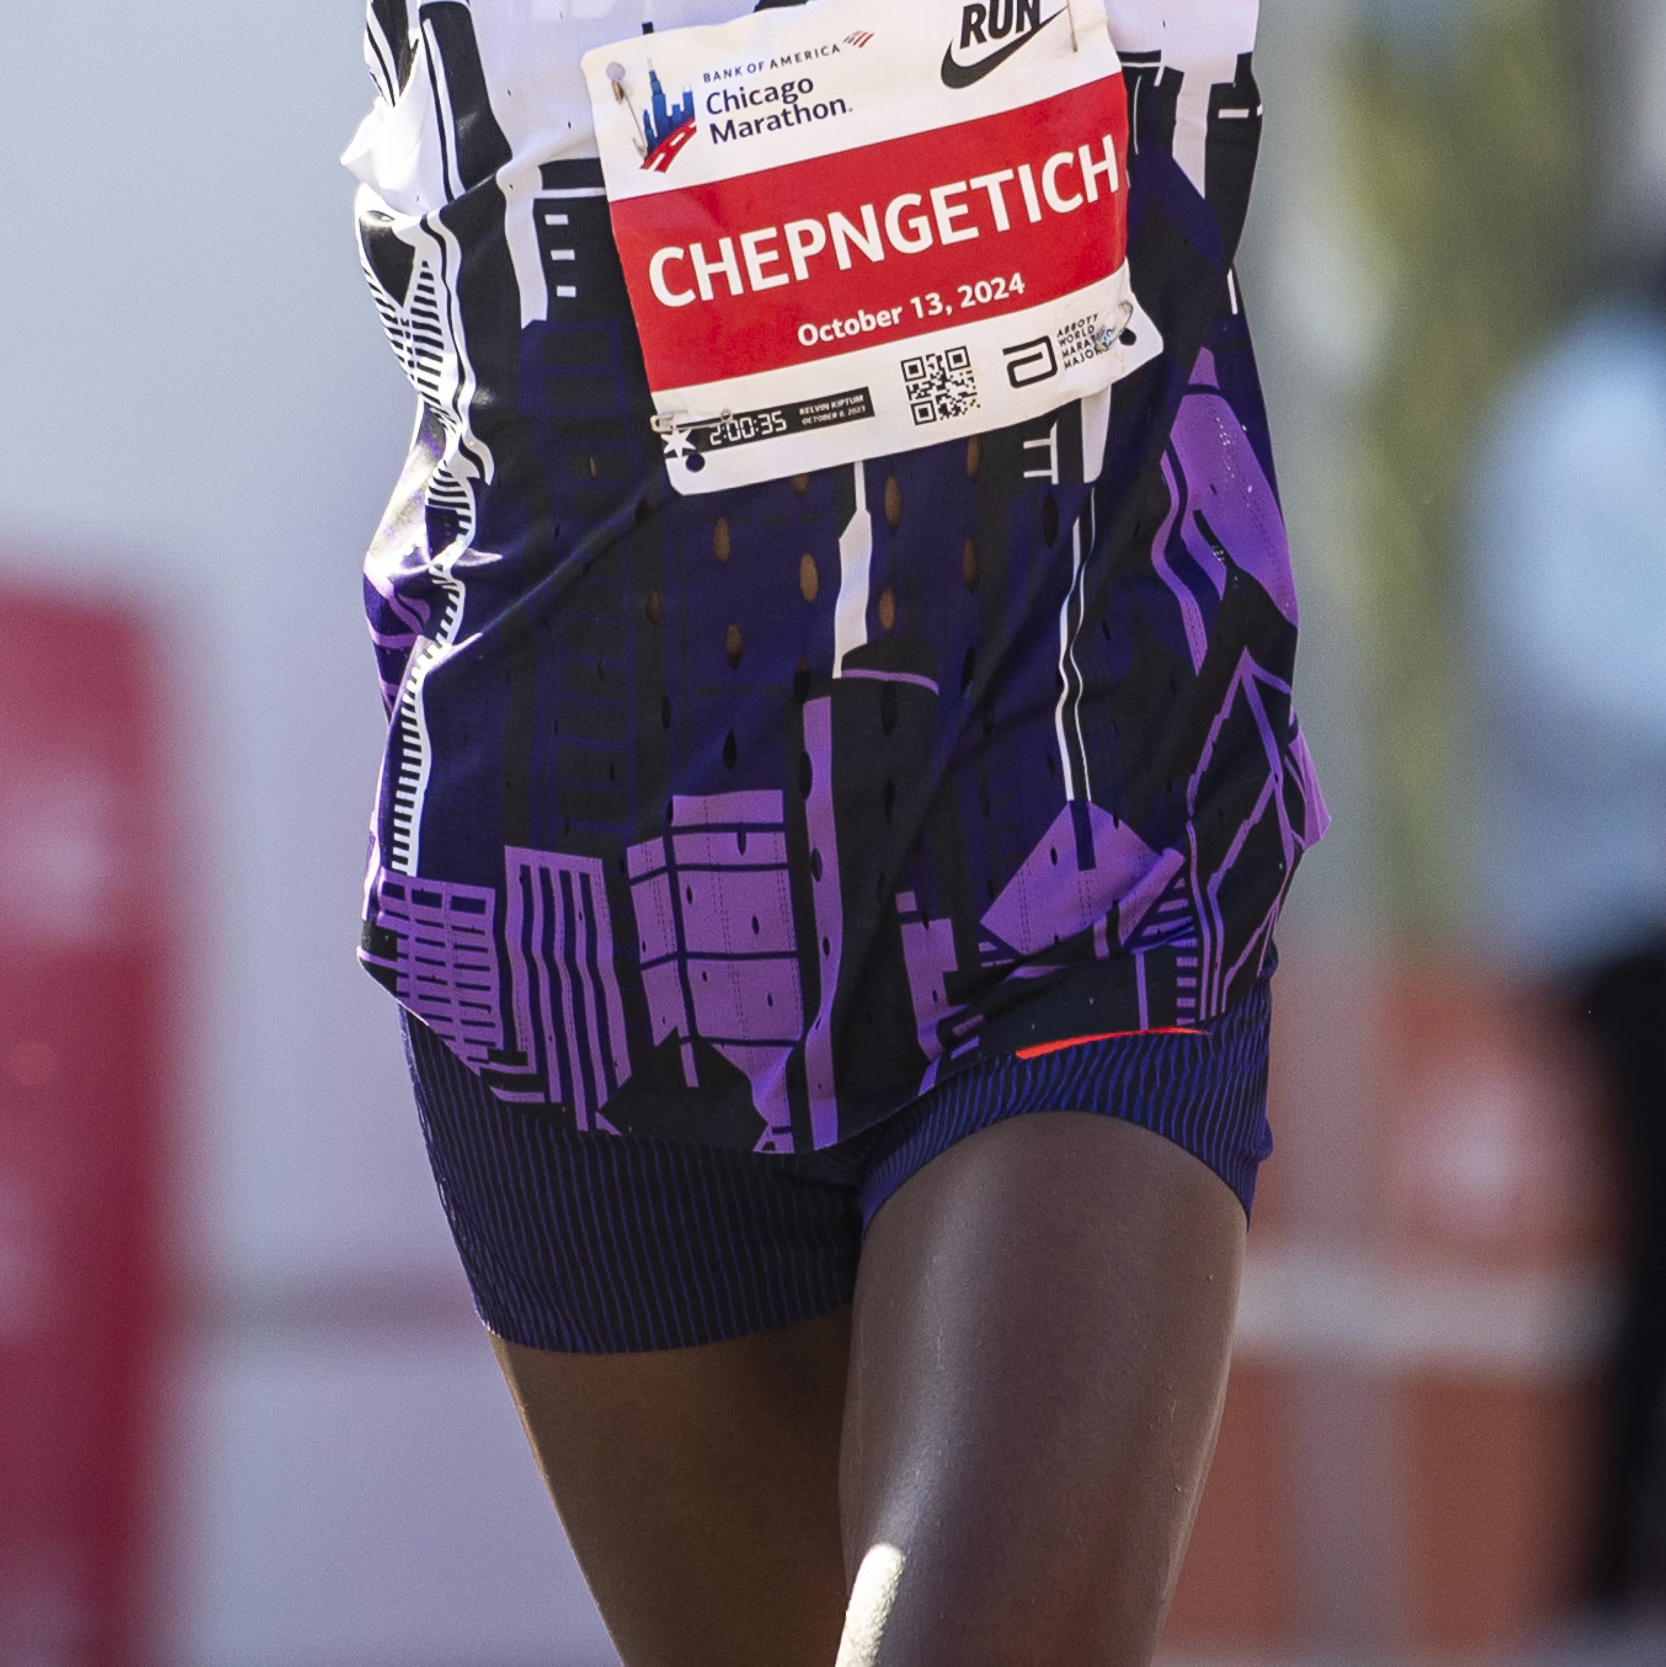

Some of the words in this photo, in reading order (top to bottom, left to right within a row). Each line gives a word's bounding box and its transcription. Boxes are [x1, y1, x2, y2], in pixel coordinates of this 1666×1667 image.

[703, 66, 743, 83] BANK
[746, 61, 765, 74] OF
[769, 43, 841, 69] AMERICA
[706, 77, 814, 115] Chicago
[649, 134, 1120, 308] CHEPNGETICH
[797, 309, 903, 346] October
[910, 292, 953, 319] 13,
[957, 272, 1026, 308] 2024
[1057, 313, 1098, 338] ABBOTT
[1058, 325, 1095, 347] WORLD
[1064, 345, 1105, 371] MAJOR
[710, 410, 787, 446] 2:00:35
